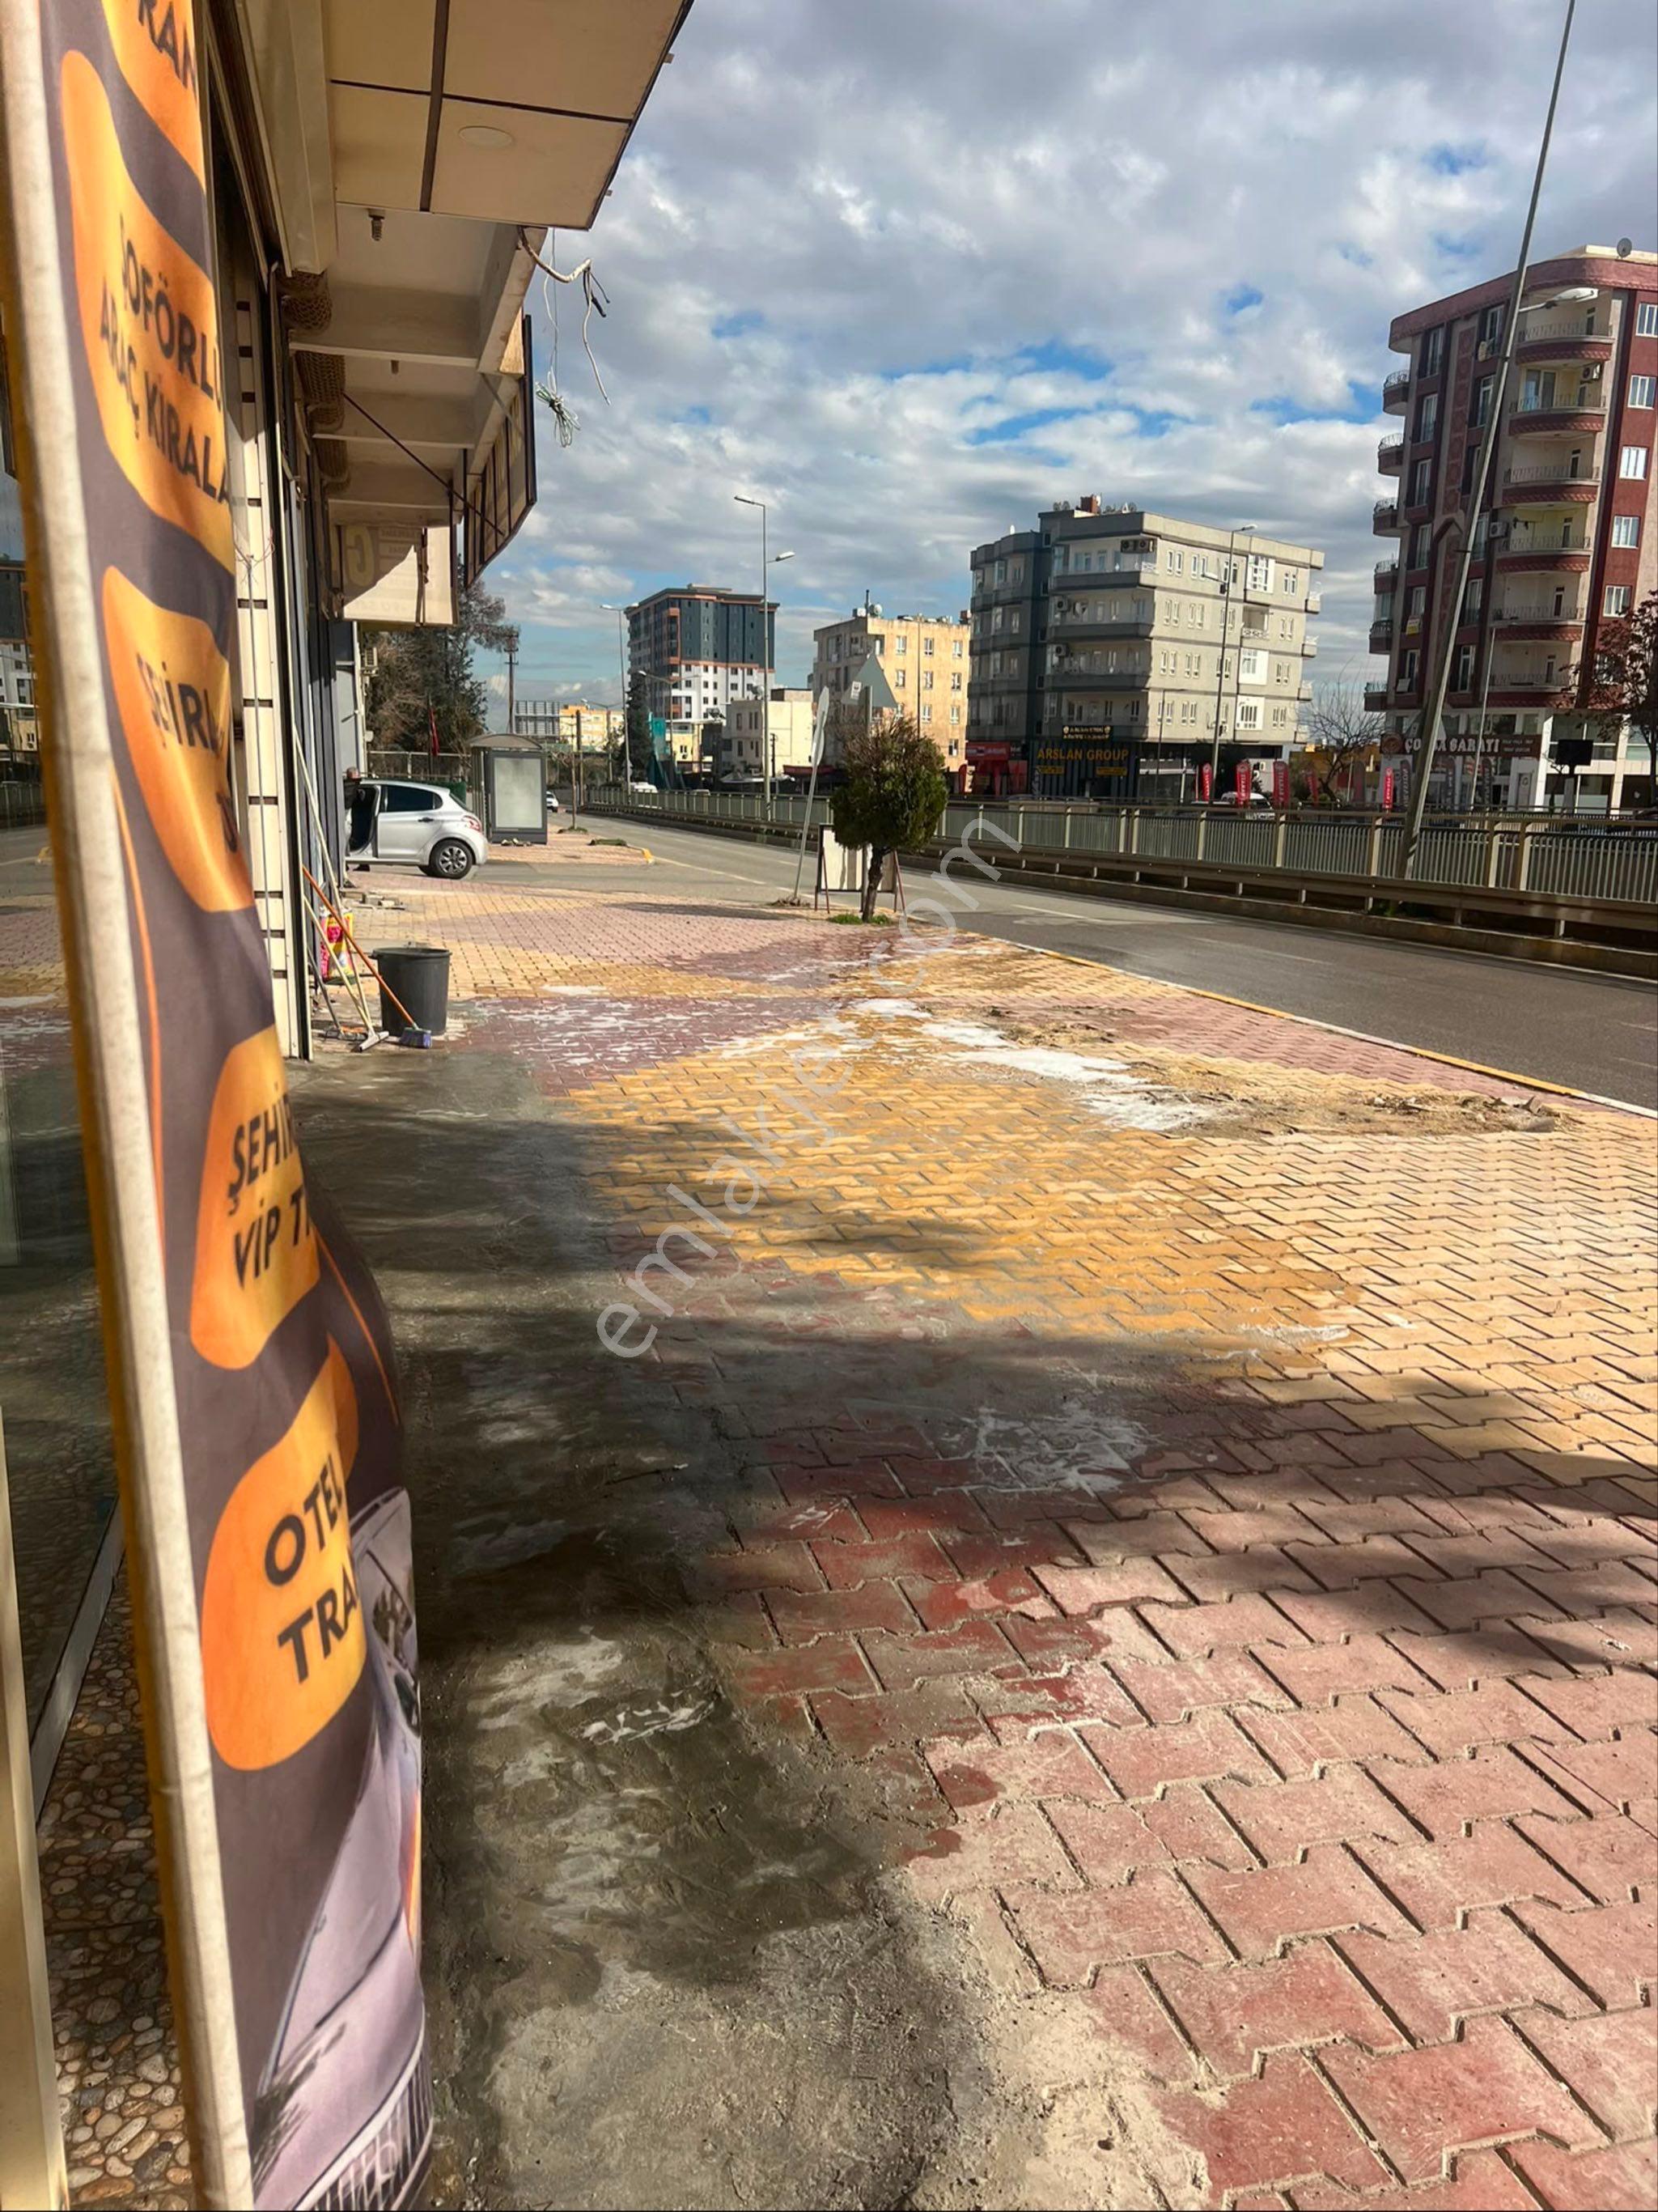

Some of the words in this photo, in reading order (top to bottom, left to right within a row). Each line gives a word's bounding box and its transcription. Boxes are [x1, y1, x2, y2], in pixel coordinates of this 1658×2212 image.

[1037, 749, 1083, 759] ARSLAN
[1087, 749, 1129, 761] GROUP
[1405, 737, 1447, 754] ÇOA
[234, 1198, 281, 1291] VİP
[264, 1454, 343, 1587] OTEL
